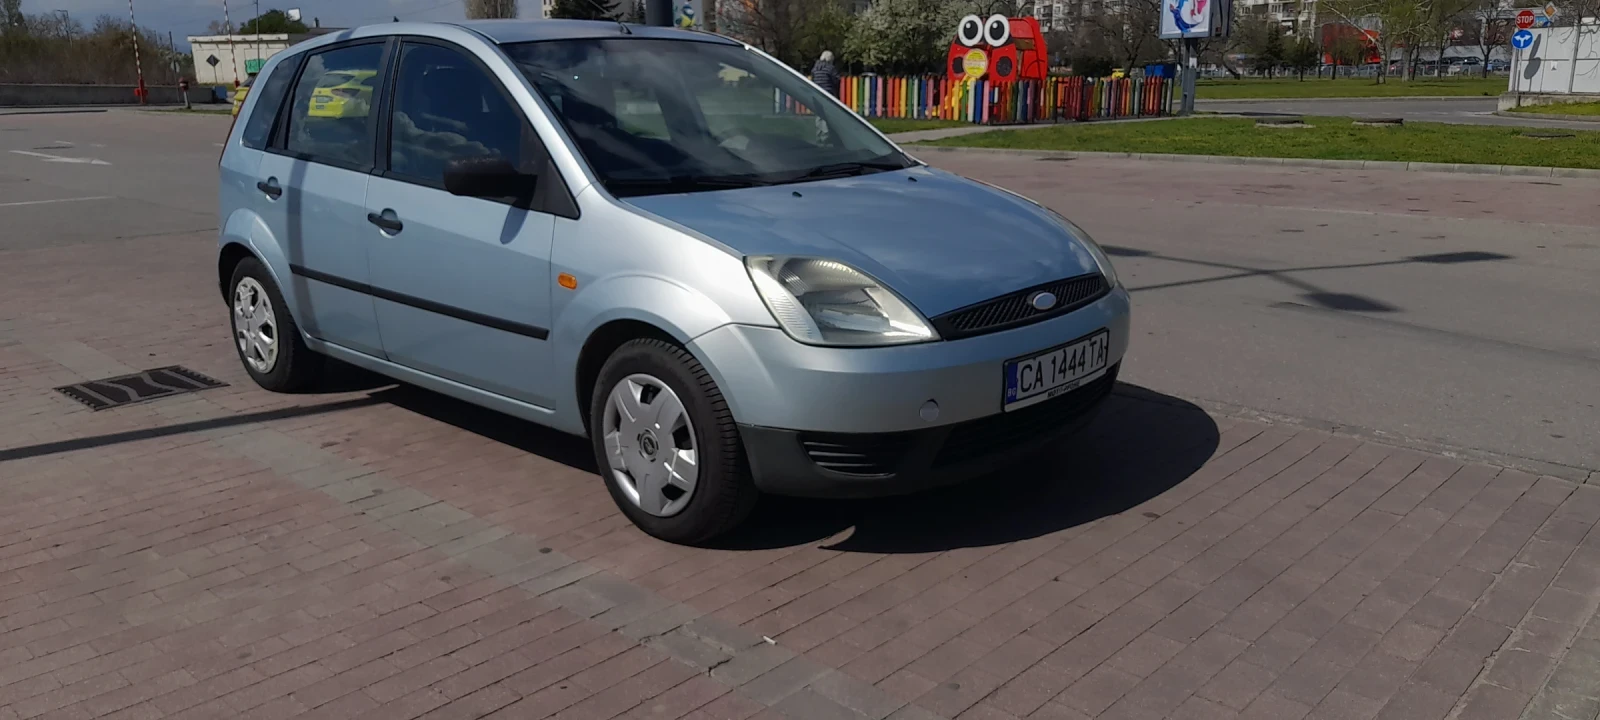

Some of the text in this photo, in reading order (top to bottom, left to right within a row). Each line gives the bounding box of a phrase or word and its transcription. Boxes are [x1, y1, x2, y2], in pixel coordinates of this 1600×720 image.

[1516, 15, 1534, 24] STOP
[1020, 361, 1043, 393] CA
[1051, 345, 1086, 383] 1444
[1089, 337, 1104, 368] TA
[1007, 387, 1017, 397] BG
